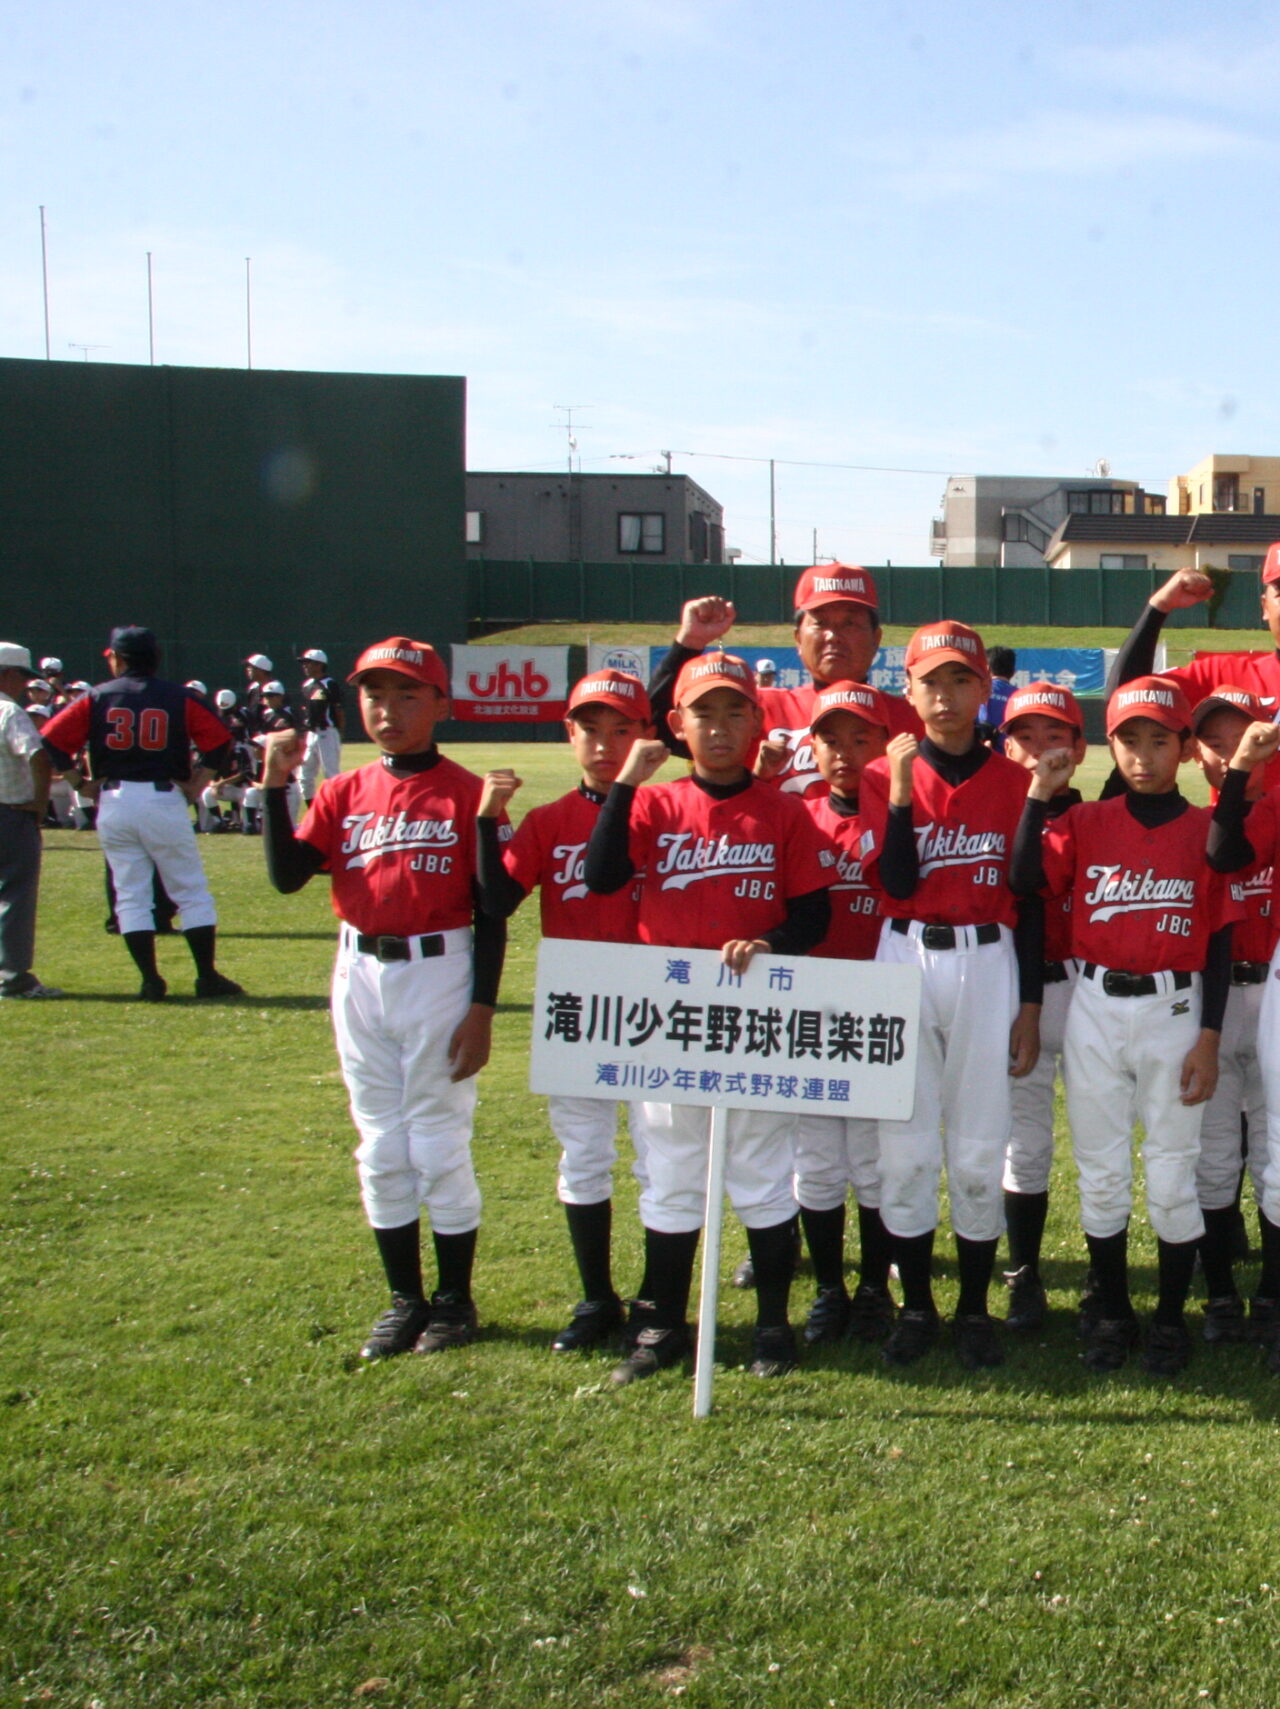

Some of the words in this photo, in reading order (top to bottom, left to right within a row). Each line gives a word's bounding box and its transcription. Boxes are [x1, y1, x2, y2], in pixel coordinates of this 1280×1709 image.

[813, 576, 866, 594] TAKIKAWA
[920, 633, 978, 655] TAKIKAWA
[367, 646, 424, 666] TAKIKAWA
[607, 659, 638, 669] MILK
[468, 659, 551, 699] uhb
[690, 661, 747, 681] TAKIKAWA
[580, 679, 636, 699] TAKIKAWA
[820, 689, 874, 708] TAKIKAWA
[1117, 690, 1174, 708] TAKIKAWA
[1013, 692, 1066, 711] TAKIKAWA
[106, 707, 168, 751] 30
[342, 811, 458, 858] Takikawa
[410, 853, 453, 874] JBC
[657, 832, 776, 880] Takikawa
[734, 878, 776, 900] JBC
[1085, 864, 1195, 910] Takikawa
[1156, 913, 1192, 937] JBC
[664, 958, 795, 992] 滝川市
[595, 1062, 851, 1102] 滝川少年軟式野球連盟
